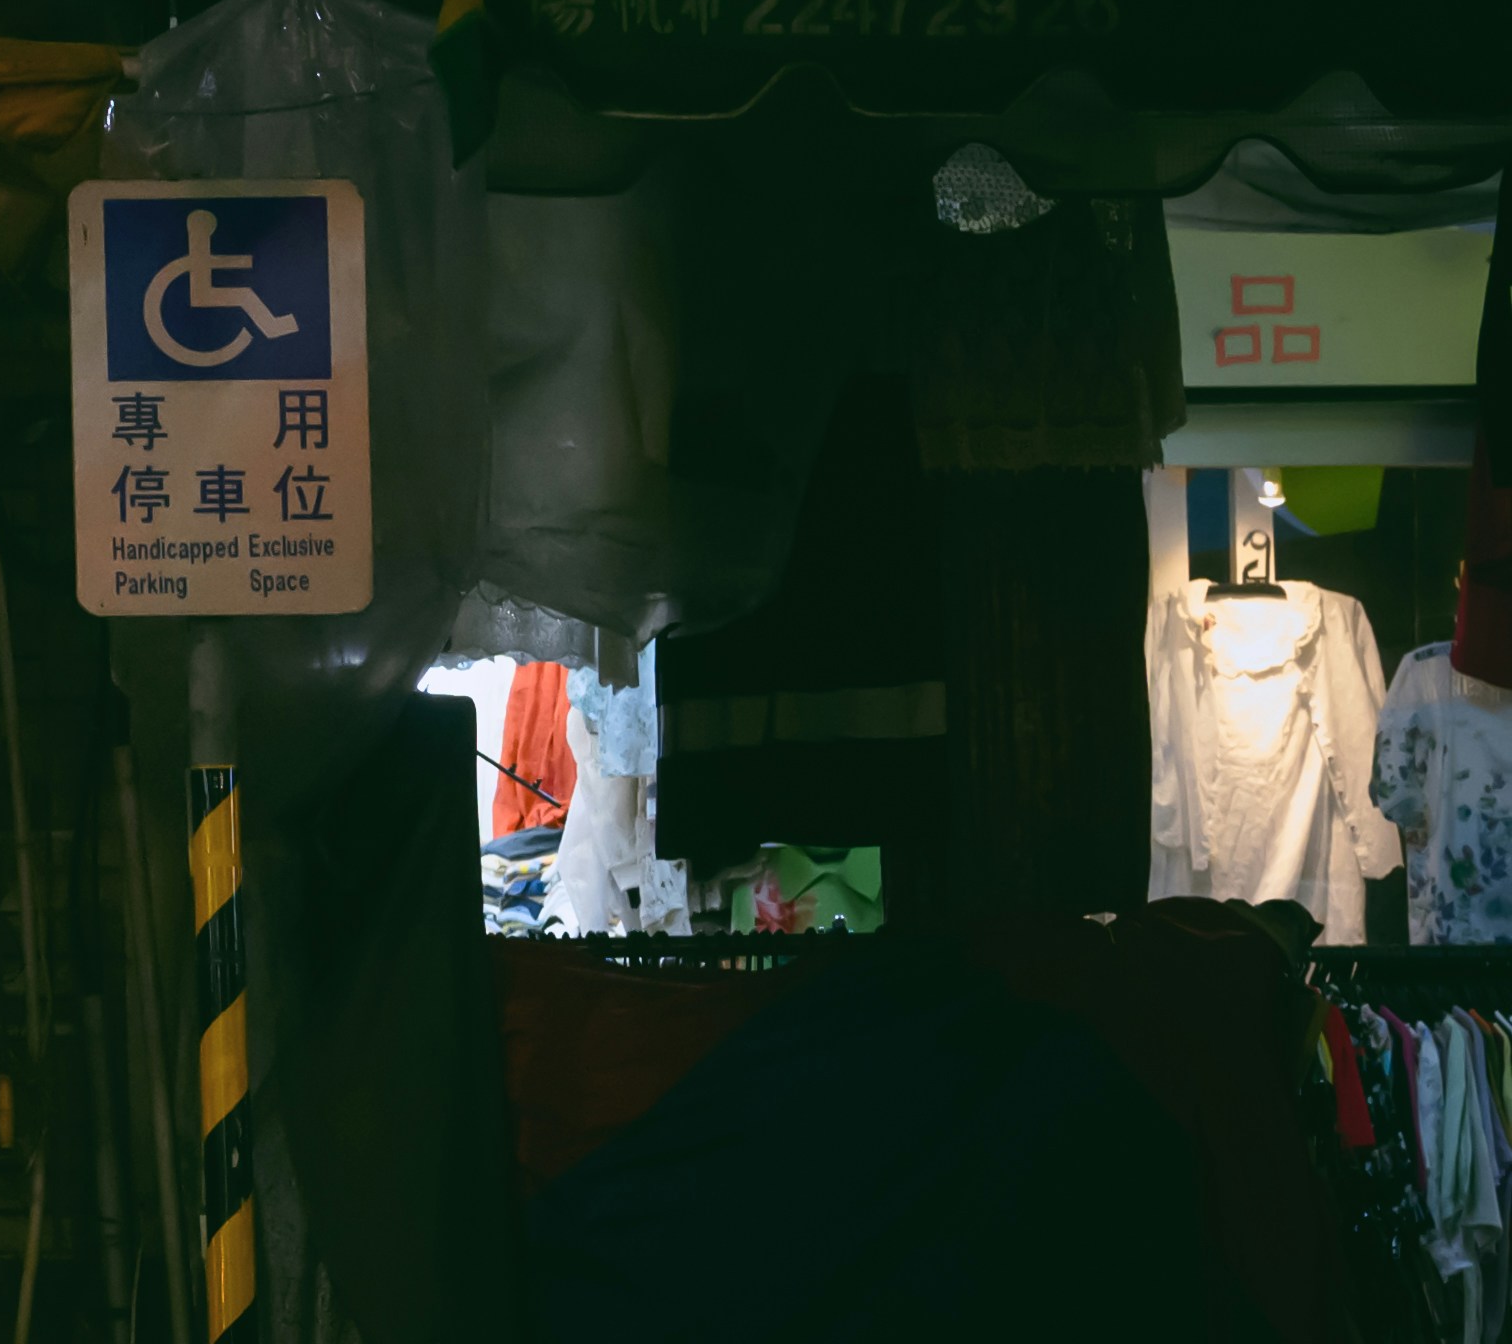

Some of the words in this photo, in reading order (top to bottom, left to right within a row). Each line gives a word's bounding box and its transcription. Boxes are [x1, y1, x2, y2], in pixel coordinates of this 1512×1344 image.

[111, 463, 334, 524] 停車位
[112, 535, 239, 564] Handicapped
[248, 534, 335, 558] Exclusive
[115, 571, 189, 599] Parking
[250, 569, 310, 597] Space
